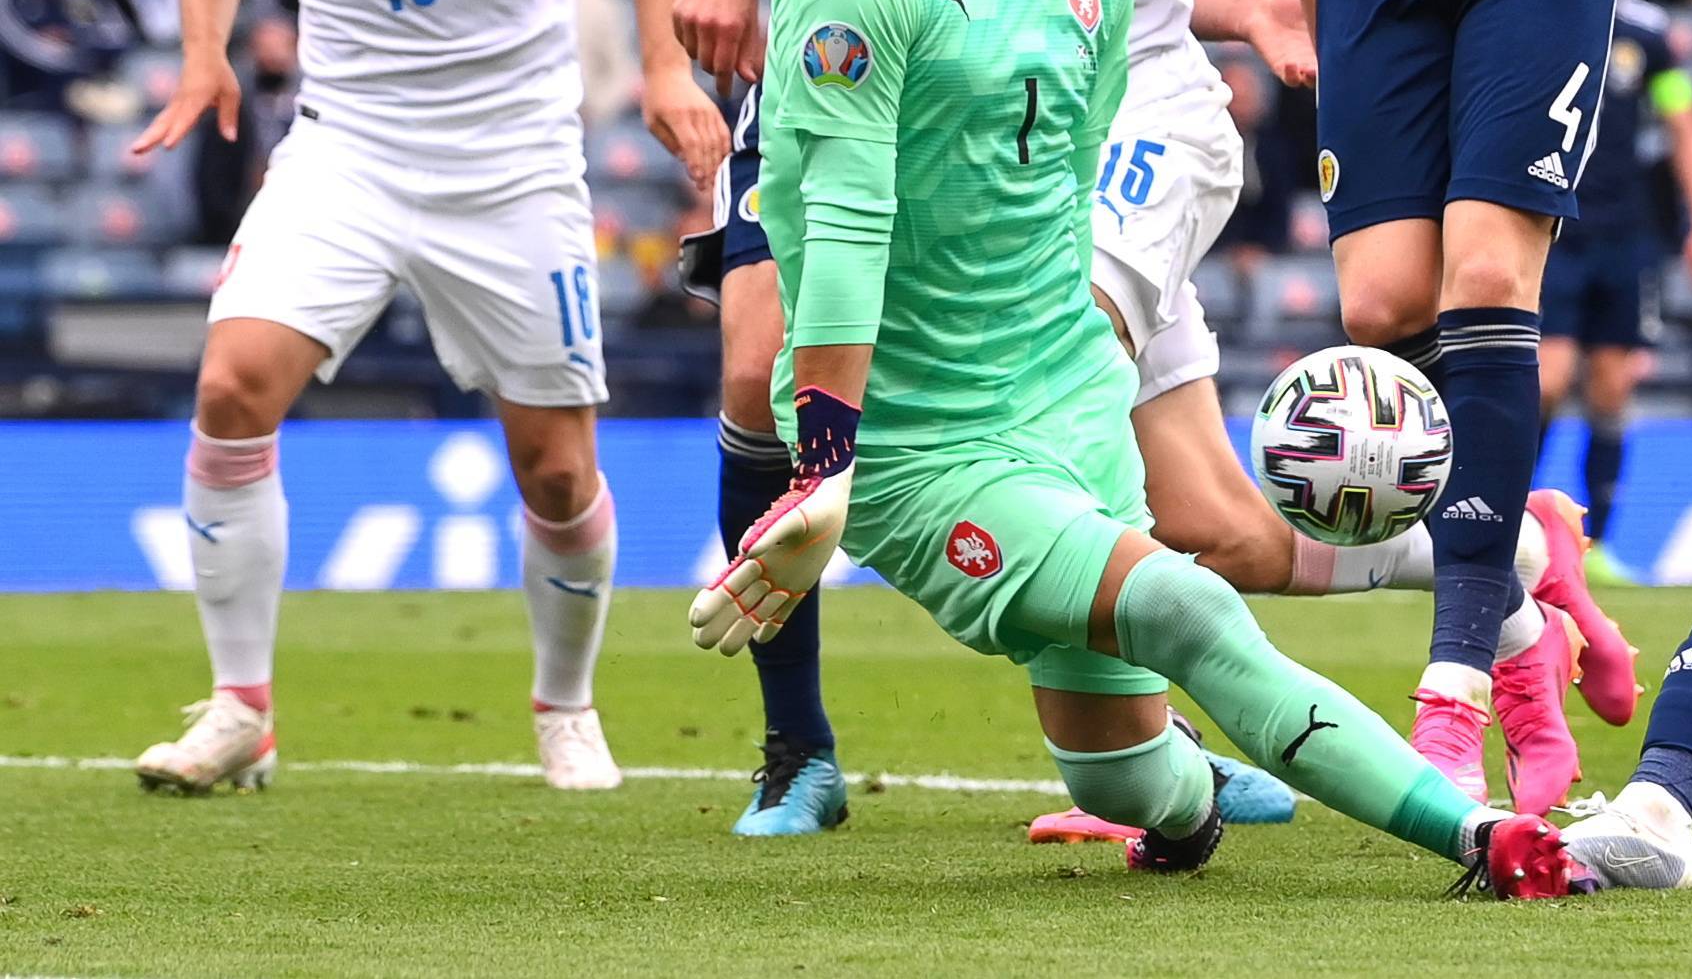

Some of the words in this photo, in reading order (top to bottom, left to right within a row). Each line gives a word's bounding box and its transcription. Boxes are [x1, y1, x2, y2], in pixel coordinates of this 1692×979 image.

[1016, 78, 1038, 165] 1
[1548, 61, 1590, 153] 4
[1096, 139, 1166, 206] 15
[550, 265, 593, 348] 18
